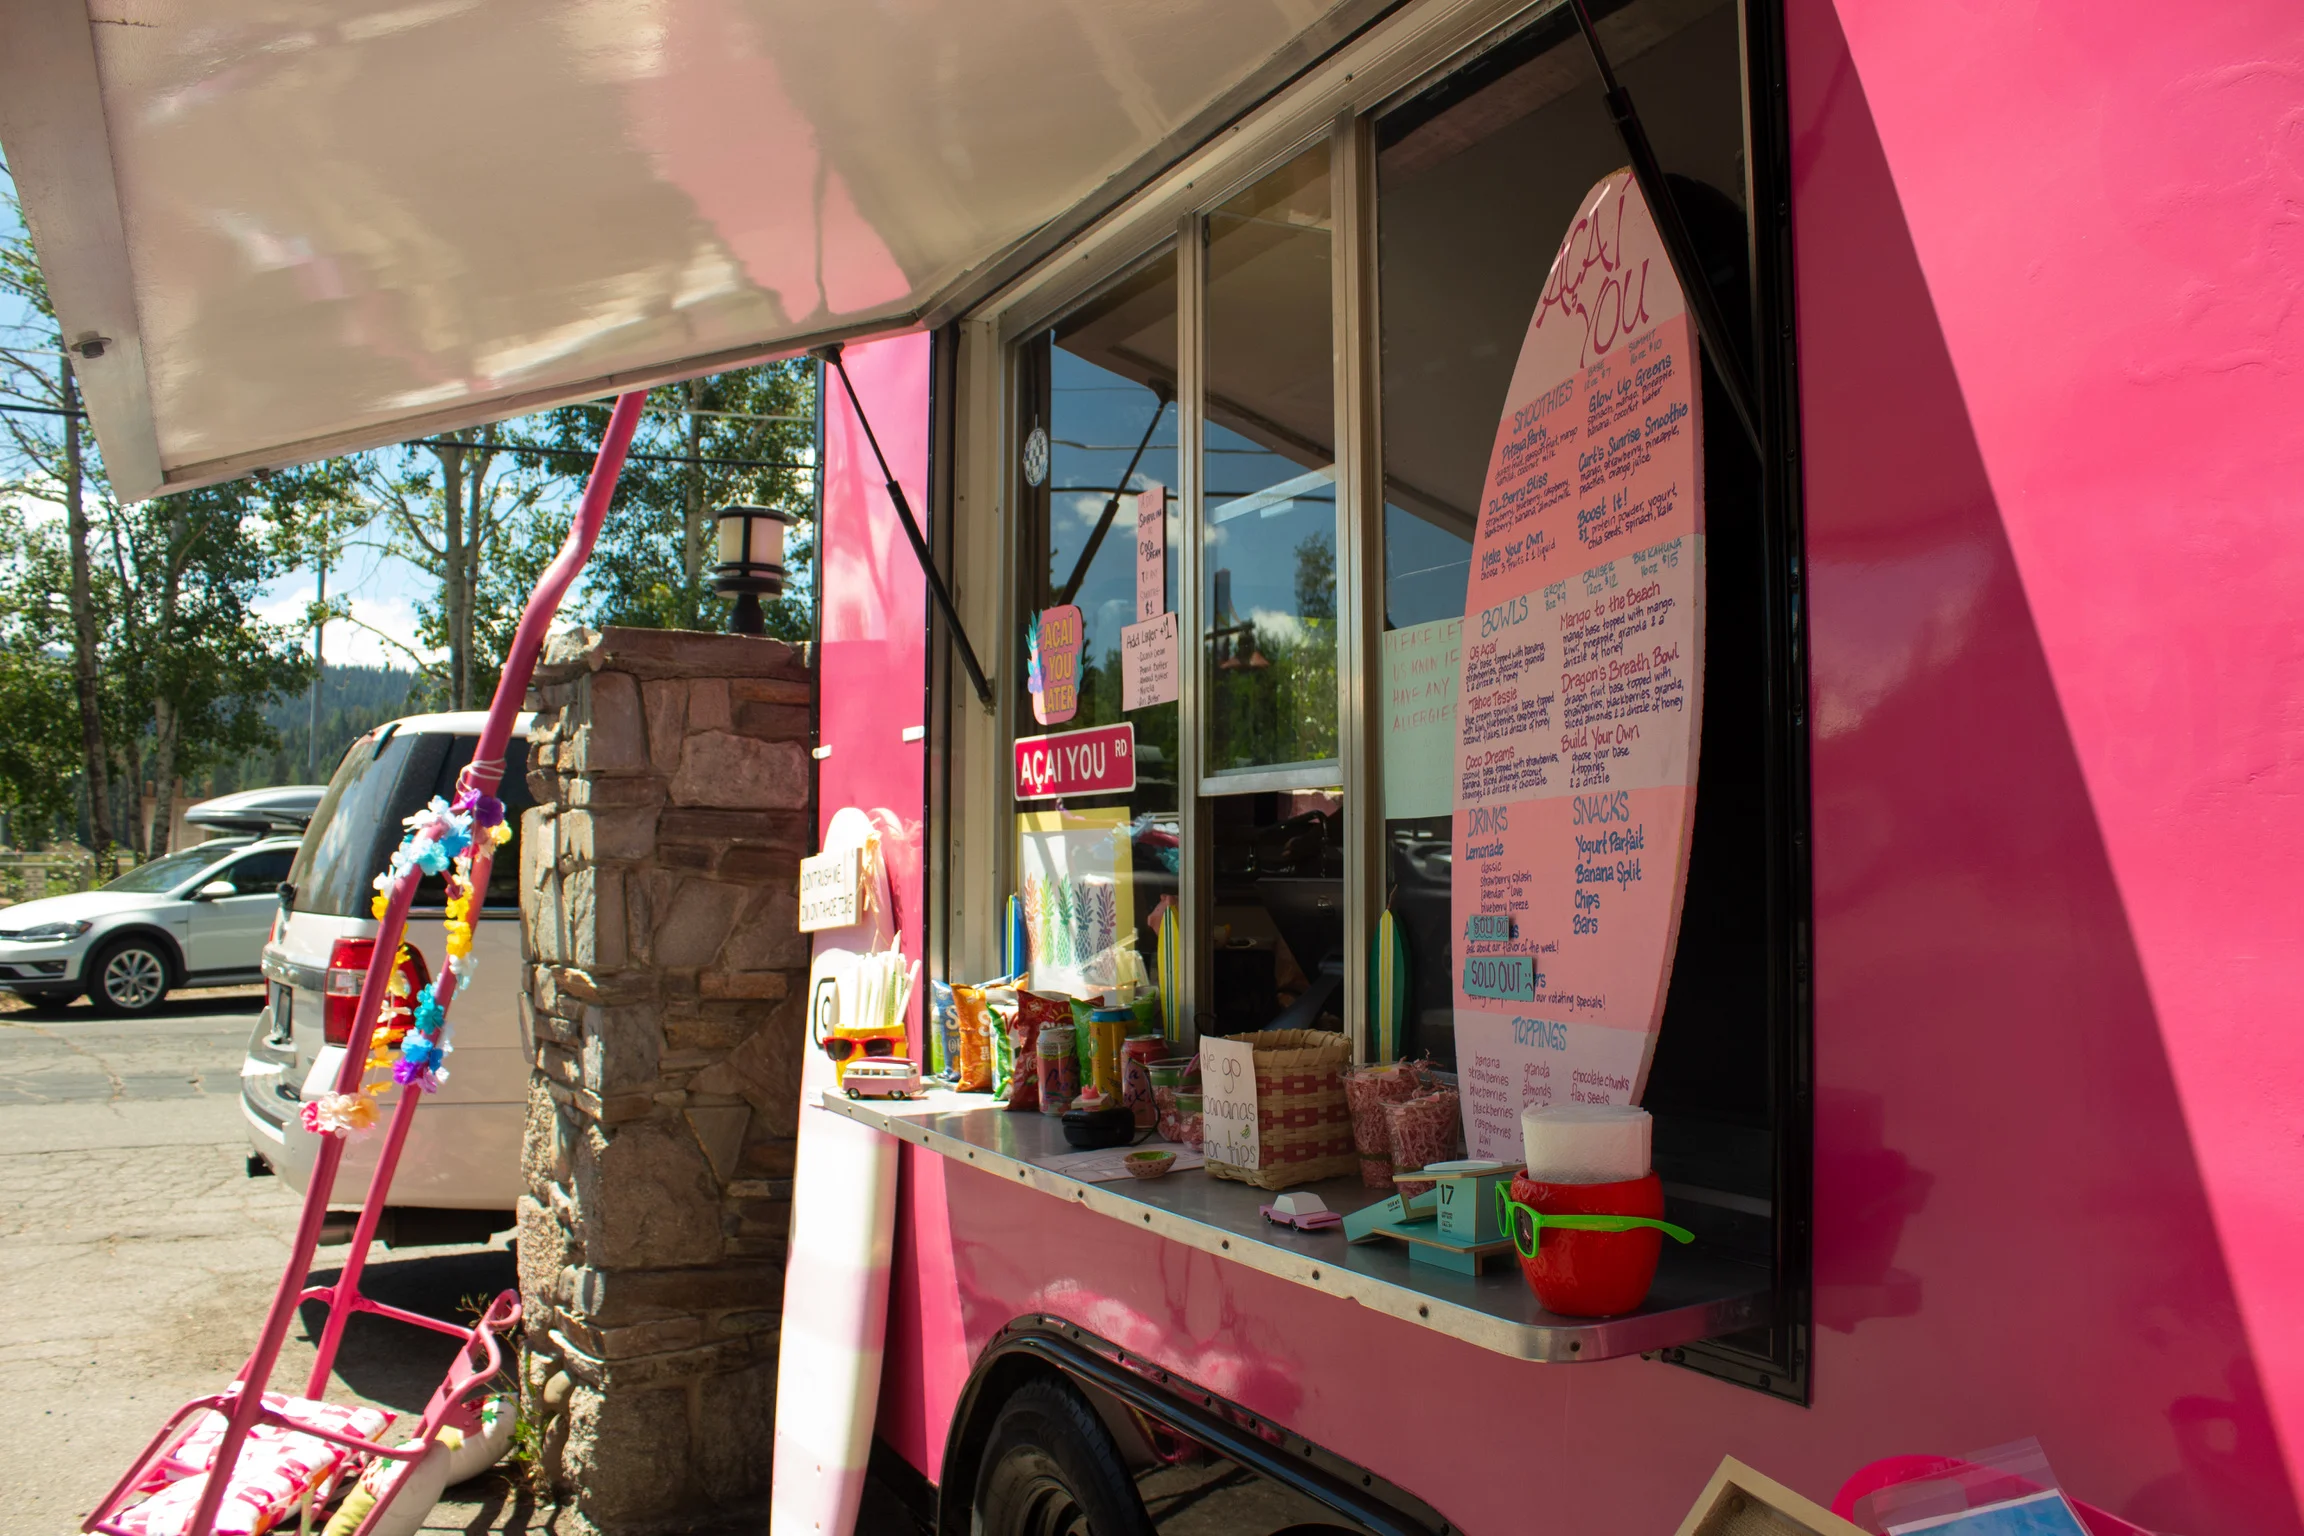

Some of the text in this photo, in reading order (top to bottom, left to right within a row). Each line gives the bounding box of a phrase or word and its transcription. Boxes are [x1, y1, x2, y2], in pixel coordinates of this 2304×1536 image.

[1576, 258, 1649, 369] YOU
[1589, 355, 1671, 413] Glow Up Greens
[1513, 379, 1573, 435] SMOOTHIES
[1579, 446, 1604, 472] Curt's
[1608, 428, 1641, 456] Sunrise
[1645, 402, 1688, 437] Smoothie
[1527, 473, 1548, 494] Bliss
[1578, 487, 1627, 528] Boost It!
[1657, 502, 1673, 518] kale
[1592, 516, 1615, 536] protein
[1139, 540, 1154, 556] COCO
[1481, 530, 1544, 571] Make Your Own
[1648, 537, 1682, 559] KAHUNA
[1662, 550, 1679, 568] $15
[1583, 561, 1615, 584] CRUISER
[1145, 600, 1154, 615] $1
[1481, 595, 1528, 638] BOWLS
[1560, 581, 1661, 631] Mango to the Beach
[1044, 610, 1074, 653] AÇAÍ
[1585, 624, 1601, 637] base
[1602, 612, 1625, 631] topped
[1627, 606, 1644, 621] with
[1126, 632, 1140, 650] Add
[1385, 620, 1464, 658] PLEASE LET
[1601, 642, 1624, 662] honey
[1048, 651, 1073, 682] YOU
[1393, 664, 1407, 682] US
[1561, 641, 1680, 694] Dragon's Breath Bowl
[1393, 677, 1450, 708] HAVE ANY
[1590, 682, 1606, 698] fruit
[1609, 683, 1625, 695] base
[1626, 671, 1652, 690] topped
[1653, 665, 1672, 681] with
[1041, 684, 1075, 714] LATER
[1492, 687, 1517, 706] Tessie
[1626, 702, 1650, 716] drizzle
[1652, 697, 1660, 713] of
[1661, 695, 1683, 712] honey
[1392, 702, 1460, 735] ALLERGIES
[1561, 723, 1640, 754] Build Your Own
[1020, 739, 1127, 793] AÇAI YOU RD
[1466, 746, 1515, 771] Coco Dreams
[1594, 748, 1610, 763] your
[1612, 746, 1630, 758] base
[1583, 773, 1610, 787] drizzle
[1573, 790, 1629, 825] SNACKS
[1467, 806, 1508, 838] DRINKS
[1465, 837, 1504, 861] Lemonade
[1575, 823, 1644, 864] Yogurt Parfait
[1575, 858, 1642, 891] Banana Split
[1509, 900, 1529, 912] breeze
[1575, 889, 1600, 914] Chips
[1572, 914, 1598, 935] Bars
[1471, 960, 1496, 989] SOLD
[1498, 961, 1522, 993] OUT
[1536, 990, 1606, 1012] our rotating specials!
[1512, 1016, 1567, 1051] TOPPINGS
[1475, 1050, 1500, 1069] banana
[1524, 1060, 1551, 1083] granola
[1222, 1057, 1242, 1094] go
[1468, 1067, 1510, 1087] strawberries
[1572, 1067, 1630, 1092] chocolate chunks
[1469, 1083, 1507, 1102] blueberries
[1522, 1081, 1552, 1099] almonds
[1570, 1082, 1610, 1105] flax seeds
[1472, 1101, 1514, 1119] blackberries
[1474, 1117, 1512, 1139] raspberries
[1478, 1133, 1491, 1146] kiwi
[1203, 1124, 1256, 1168] for tips
[1440, 1183, 1455, 1205] 17
